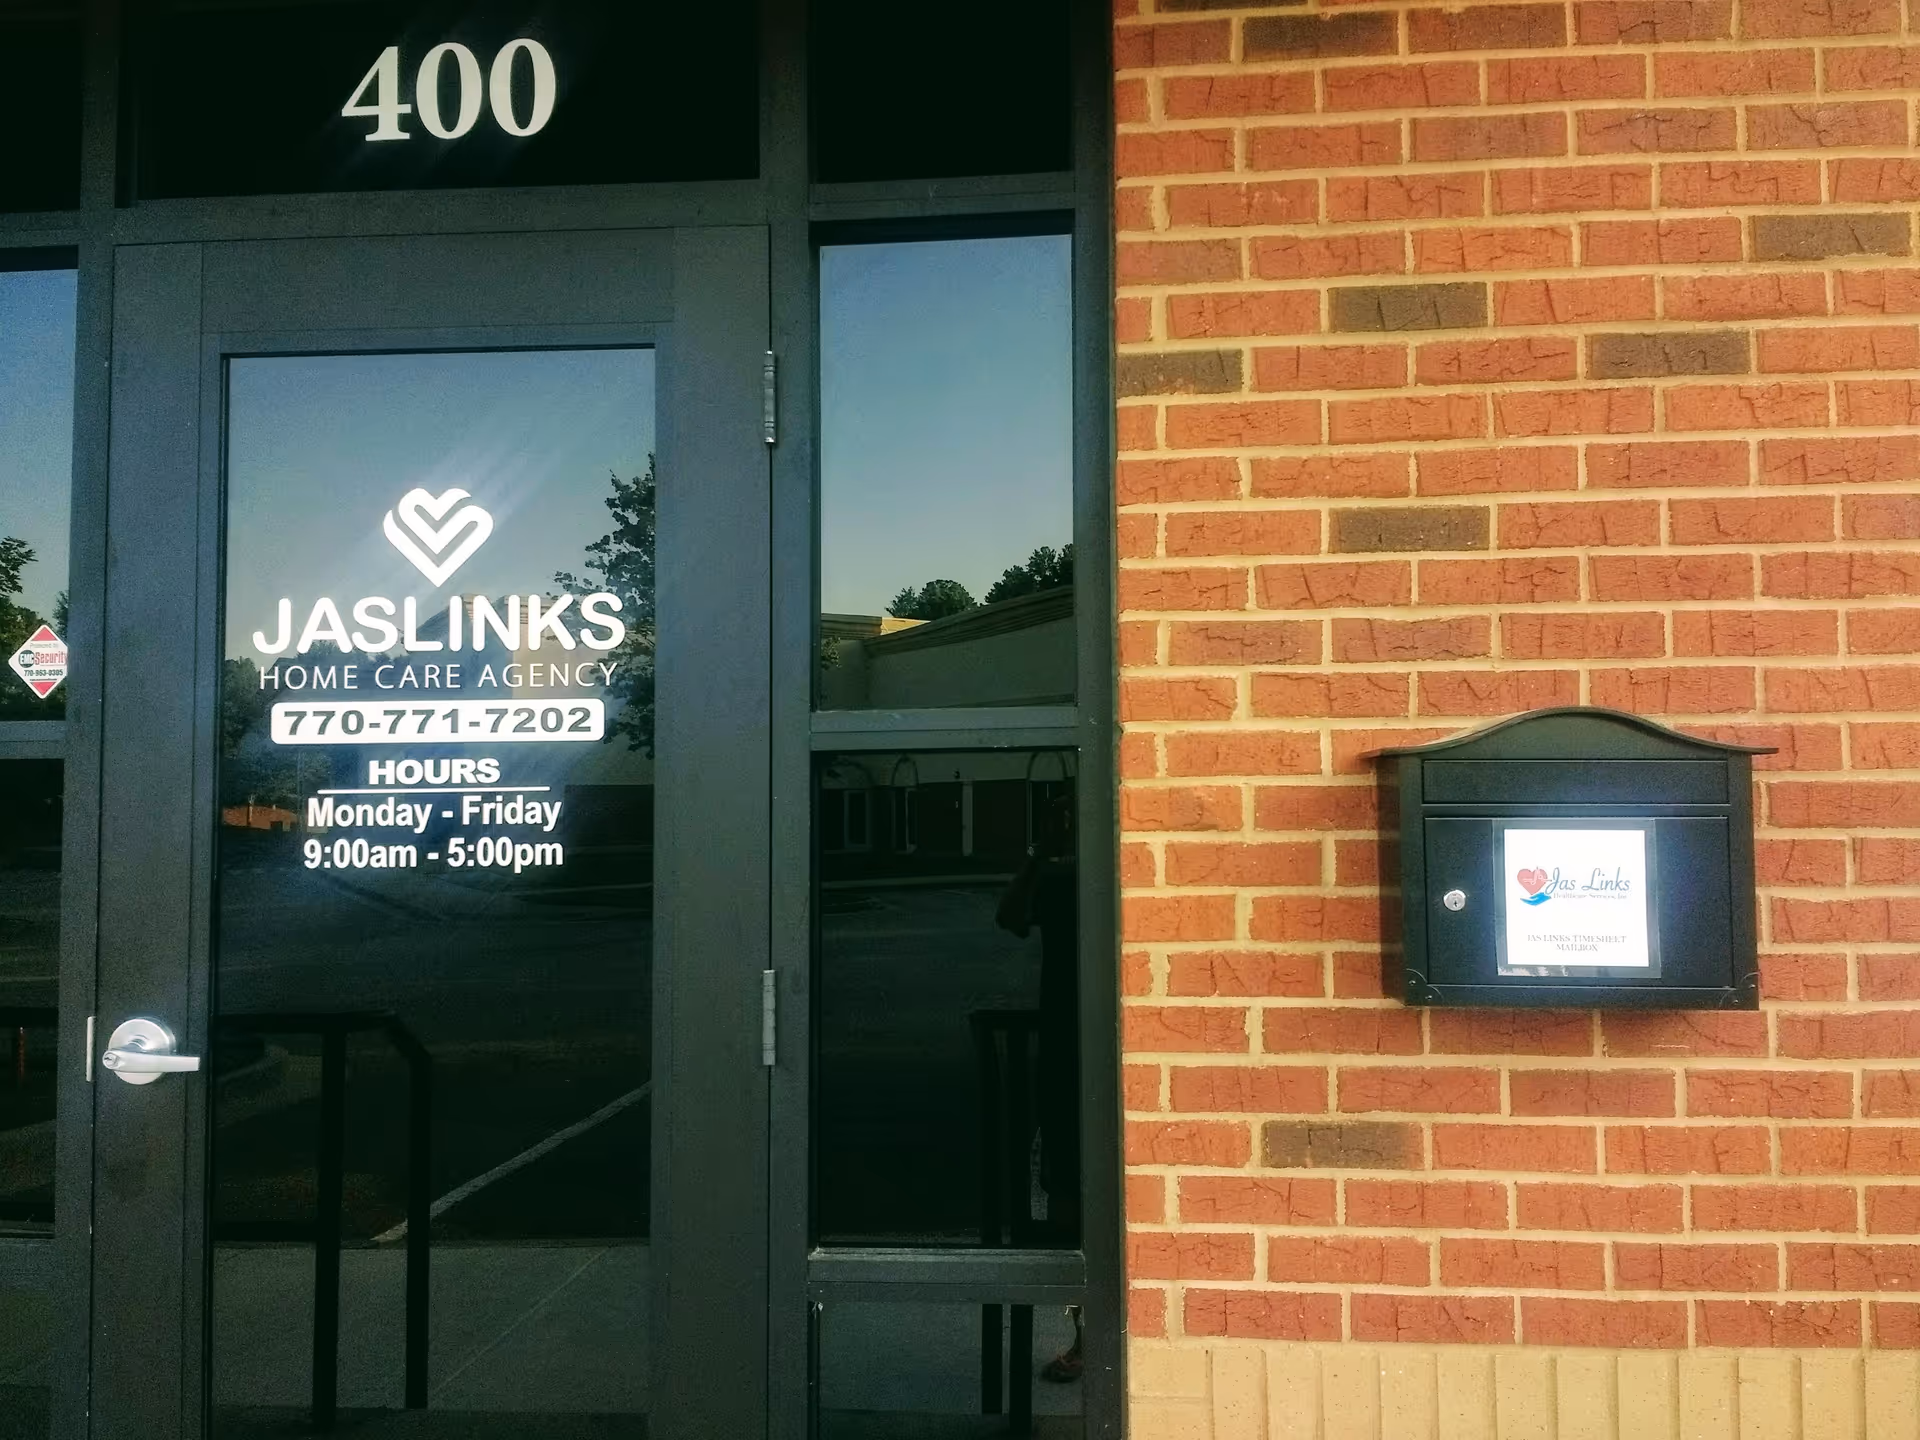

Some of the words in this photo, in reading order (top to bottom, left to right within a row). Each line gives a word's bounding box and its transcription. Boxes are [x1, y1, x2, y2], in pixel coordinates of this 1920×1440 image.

[342, 38, 556, 142] 400
[252, 593, 627, 655] JASLINKS
[259, 664, 358, 690] HOME
[374, 663, 462, 689] CARE
[477, 661, 618, 688] AGENCY
[283, 707, 592, 737] 770-771-7202
[368, 758, 501, 785] HOURS
[307, 796, 433, 834] Monday
[441, 809, 453, 819] -
[461, 794, 562, 831] Friday
[303, 837, 417, 869] 9:00am
[427, 851, 439, 861] -
[447, 836, 564, 873] 5:00pm
[1544, 867, 1577, 895] Jas
[1581, 867, 1631, 891] Links
[1544, 934, 1571, 942] LINKS
[1572, 935, 1627, 943] TIMESHEET
[1556, 944, 1599, 952] MAILBOX
